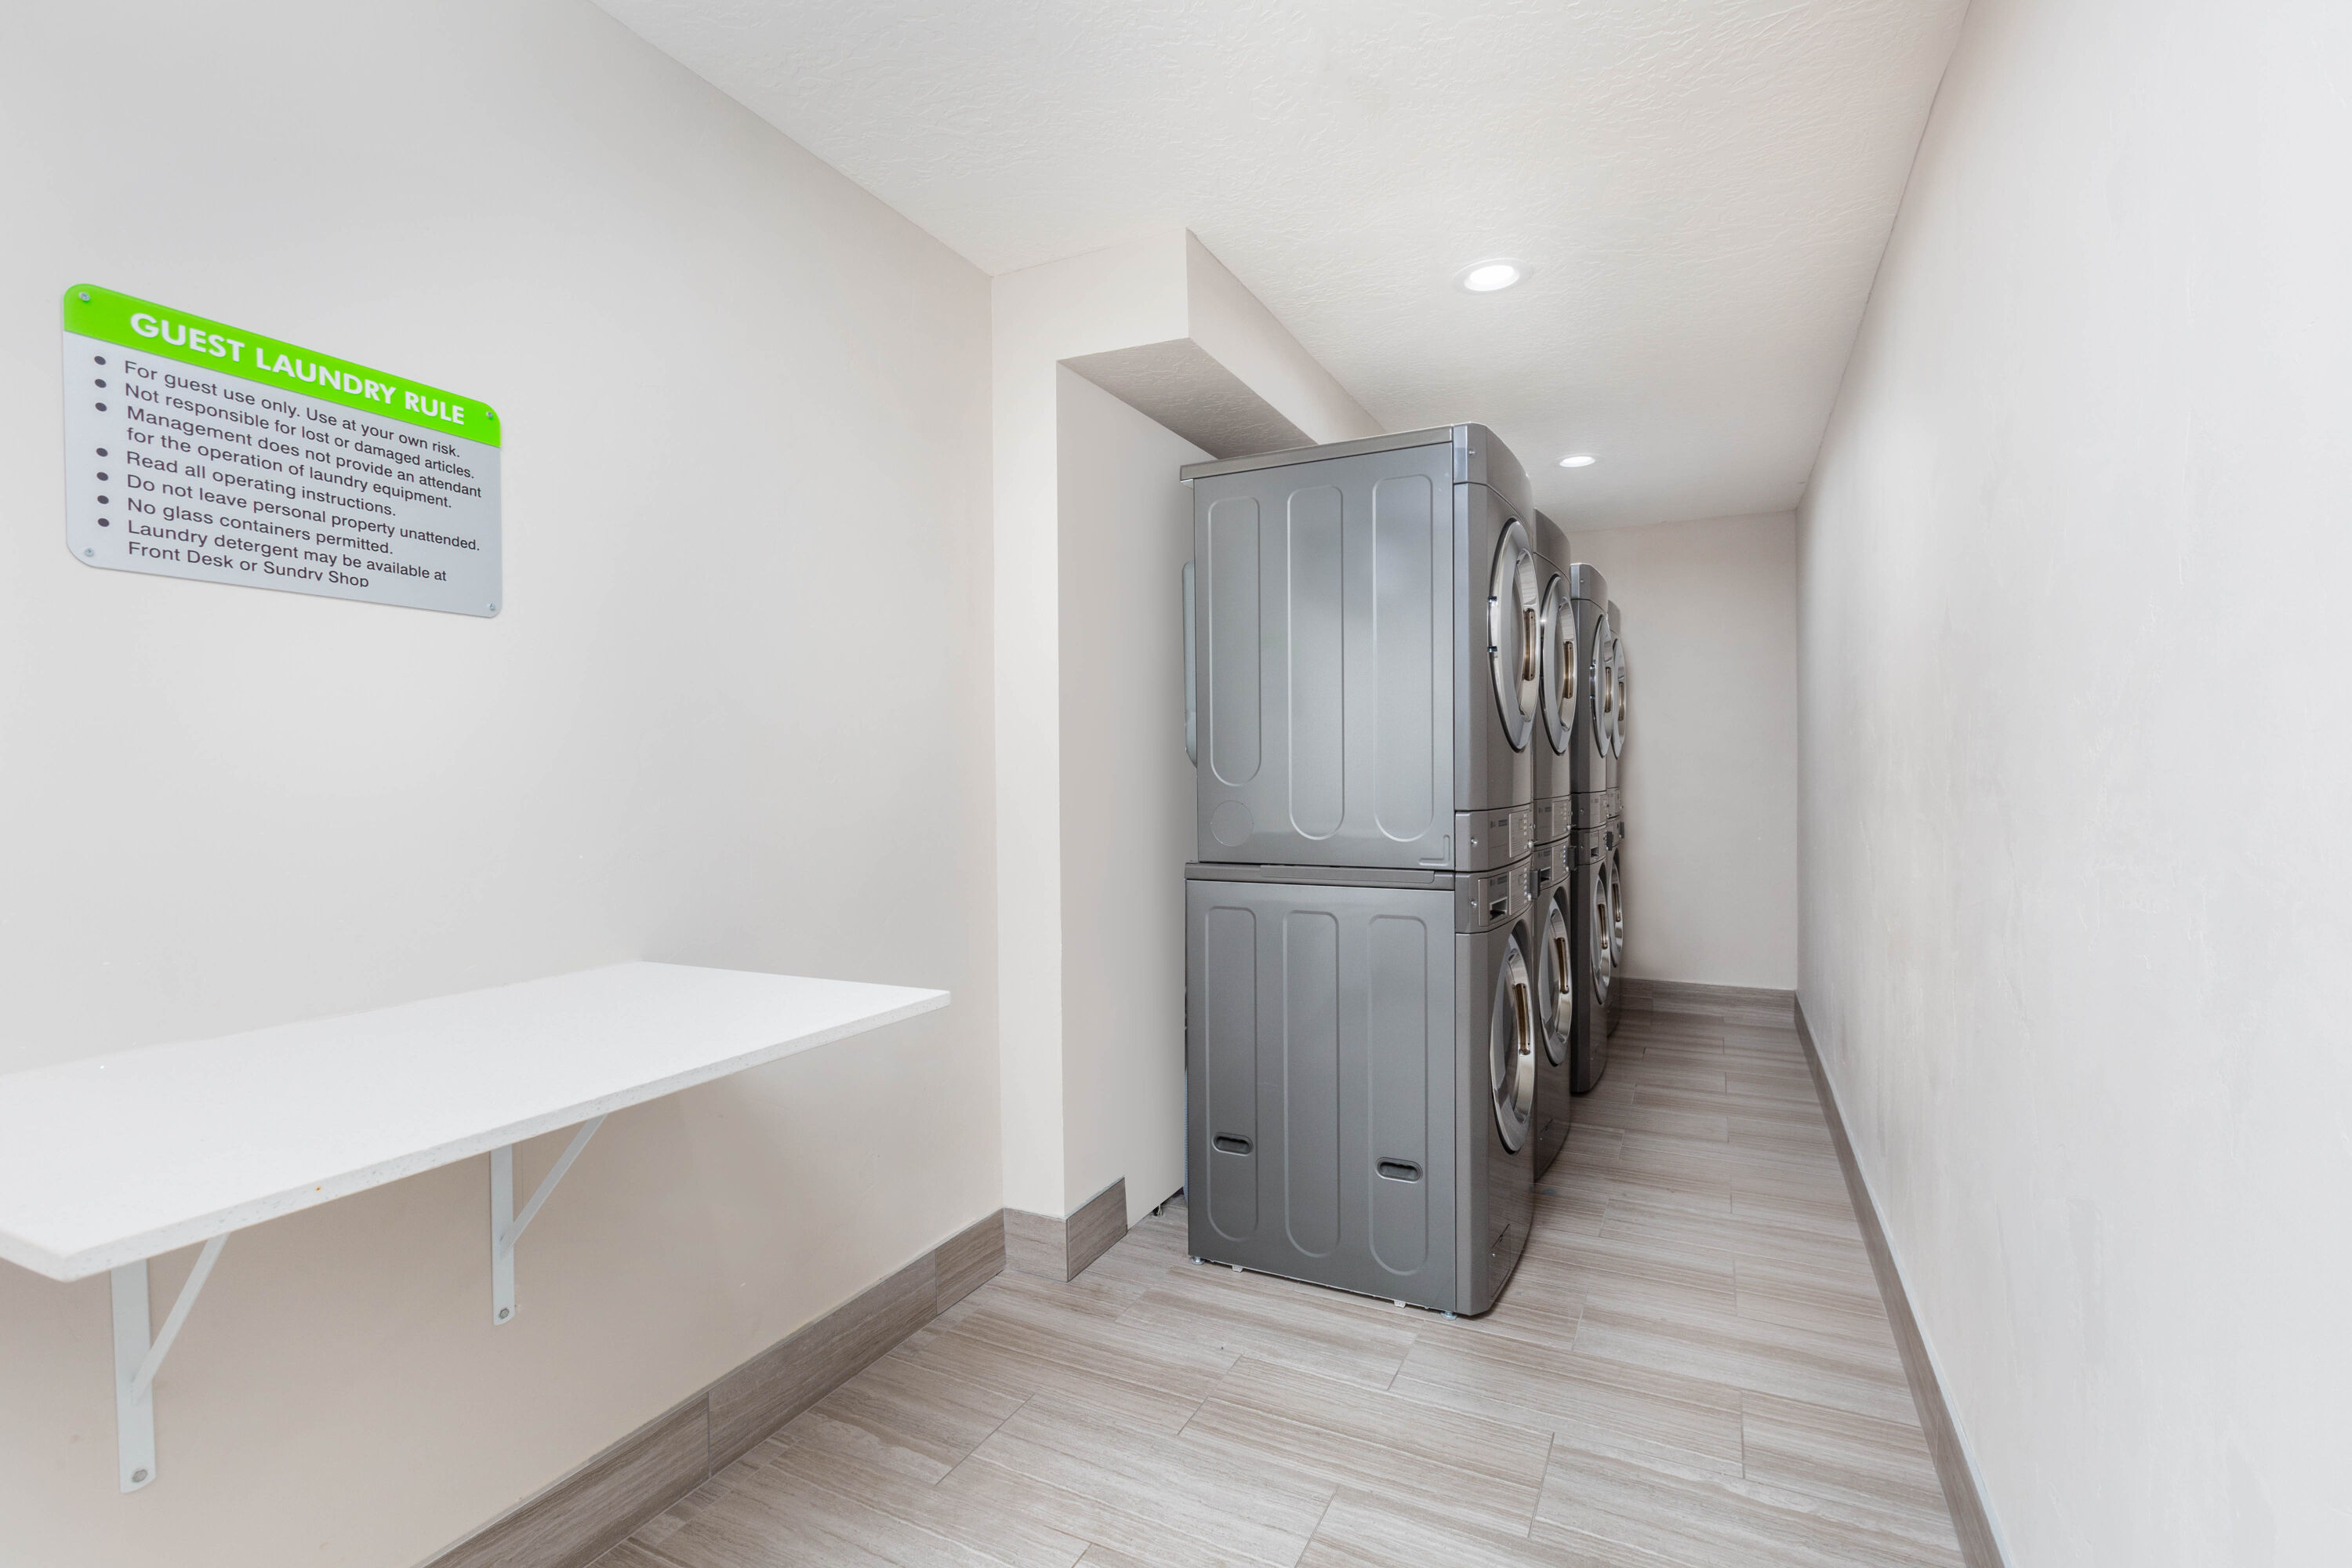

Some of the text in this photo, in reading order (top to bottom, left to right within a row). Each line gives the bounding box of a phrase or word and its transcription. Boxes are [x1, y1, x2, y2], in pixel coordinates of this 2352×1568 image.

[125, 360, 460, 458] For guest use only. Use at your own risk.
[130, 312, 464, 426] GUEST LAUNDRY RULE
[125, 382, 474, 479] Not responsible for lost or damaged articles.
[125, 426, 452, 509] for the operation of laundry equipment.
[127, 405, 482, 499] Management does not provide an attendant
[126, 450, 396, 517] Read all operating instructions.
[127, 474, 480, 551] Do not leave personal property unattended.
[127, 497, 394, 555] No glass containers permitted.
[128, 519, 448, 582] Laundry detergent may be available at
[129, 540, 181, 562] Front
[187, 549, 234, 569] Desk
[239, 560, 259, 572] or
[328, 570, 369, 588] Shop
